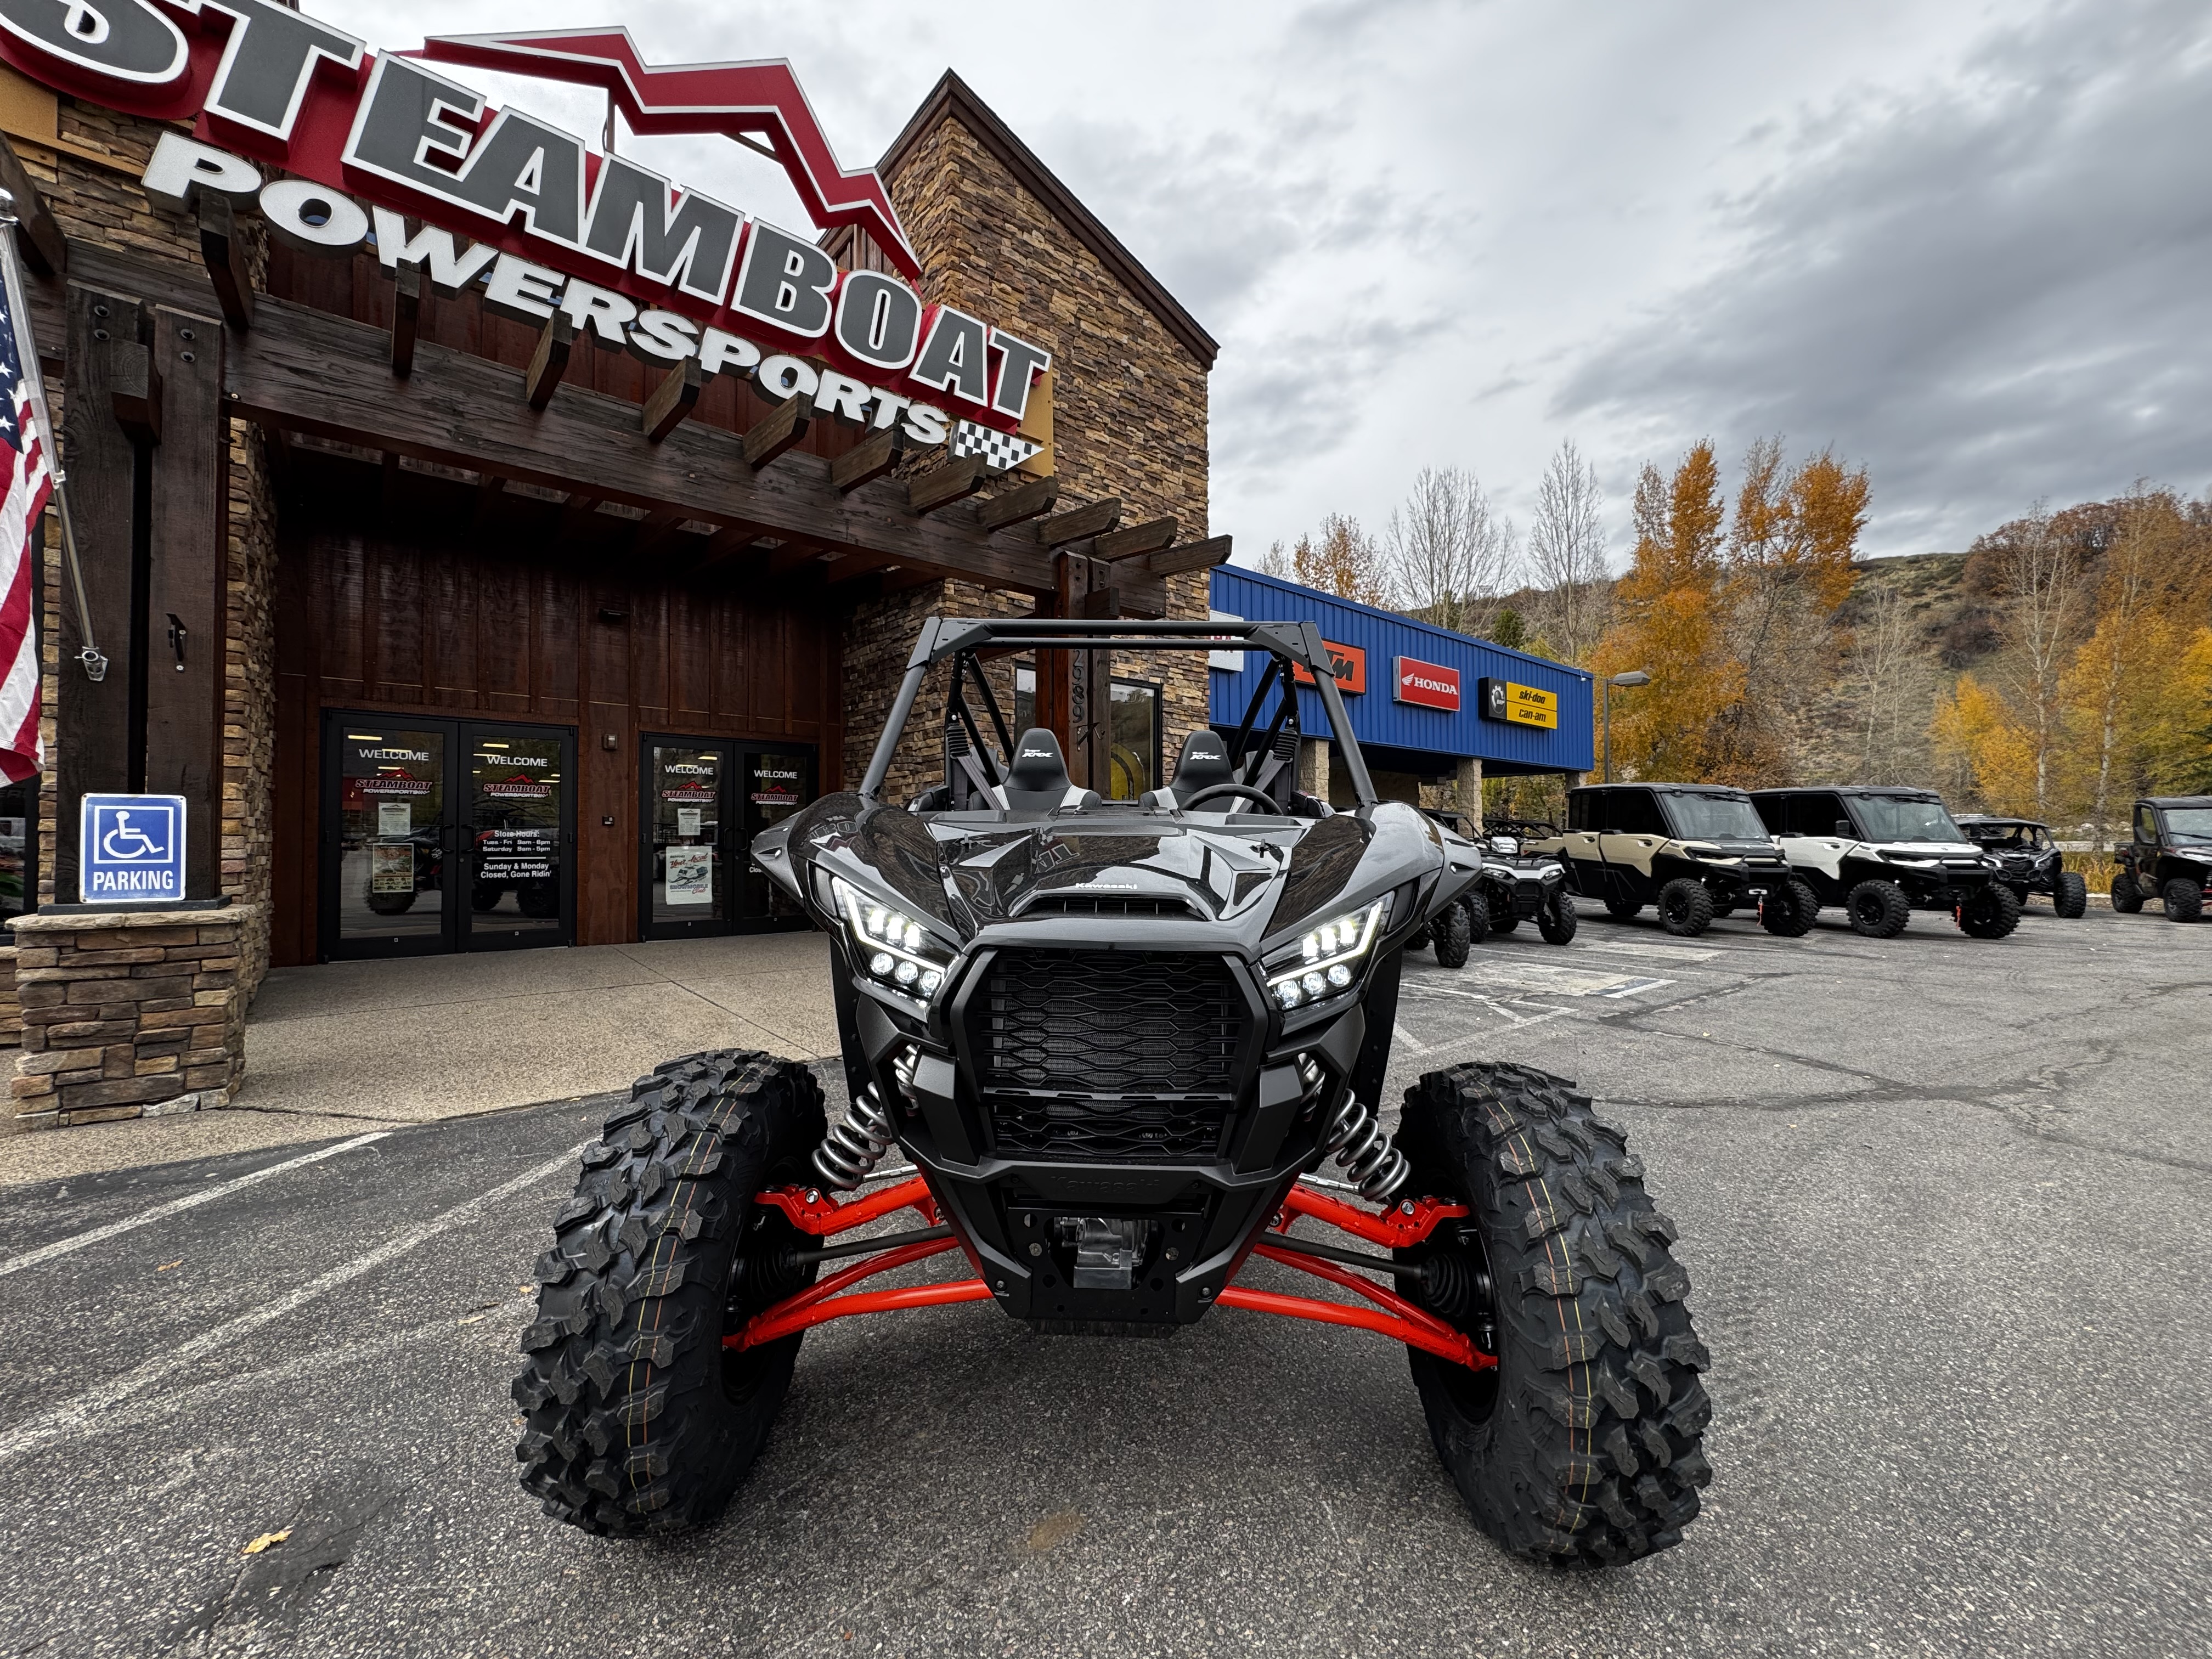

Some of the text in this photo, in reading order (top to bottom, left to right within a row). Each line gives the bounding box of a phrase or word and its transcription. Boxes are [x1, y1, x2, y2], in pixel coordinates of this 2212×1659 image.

[142, 131, 950, 445] POWERSPORTS
[1302, 649, 1354, 682] TM
[1072, 649, 1085, 723] 2989
[1414, 676, 1458, 696] HONDA
[1519, 690, 1546, 704] ski-doo
[1519, 709, 1547, 723] can-am
[359, 748, 430, 761] WELCOME
[487, 756, 548, 767] WELCOME
[665, 765, 714, 775] WELCOME
[754, 770, 798, 779] WELCOME
[355, 779, 433, 790] STEAMBOAT
[483, 783, 551, 793] STEAMBOAT
[662, 790, 716, 799] STEAMBOAT
[751, 793, 799, 802] STEAMBOAT
[484, 862, 512, 871] Sunday
[521, 862, 549, 871] Monday
[93, 870, 174, 891] PARKING
[481, 871, 509, 879] Closed,
[1049, 1176, 1160, 1195] Kawasaki
